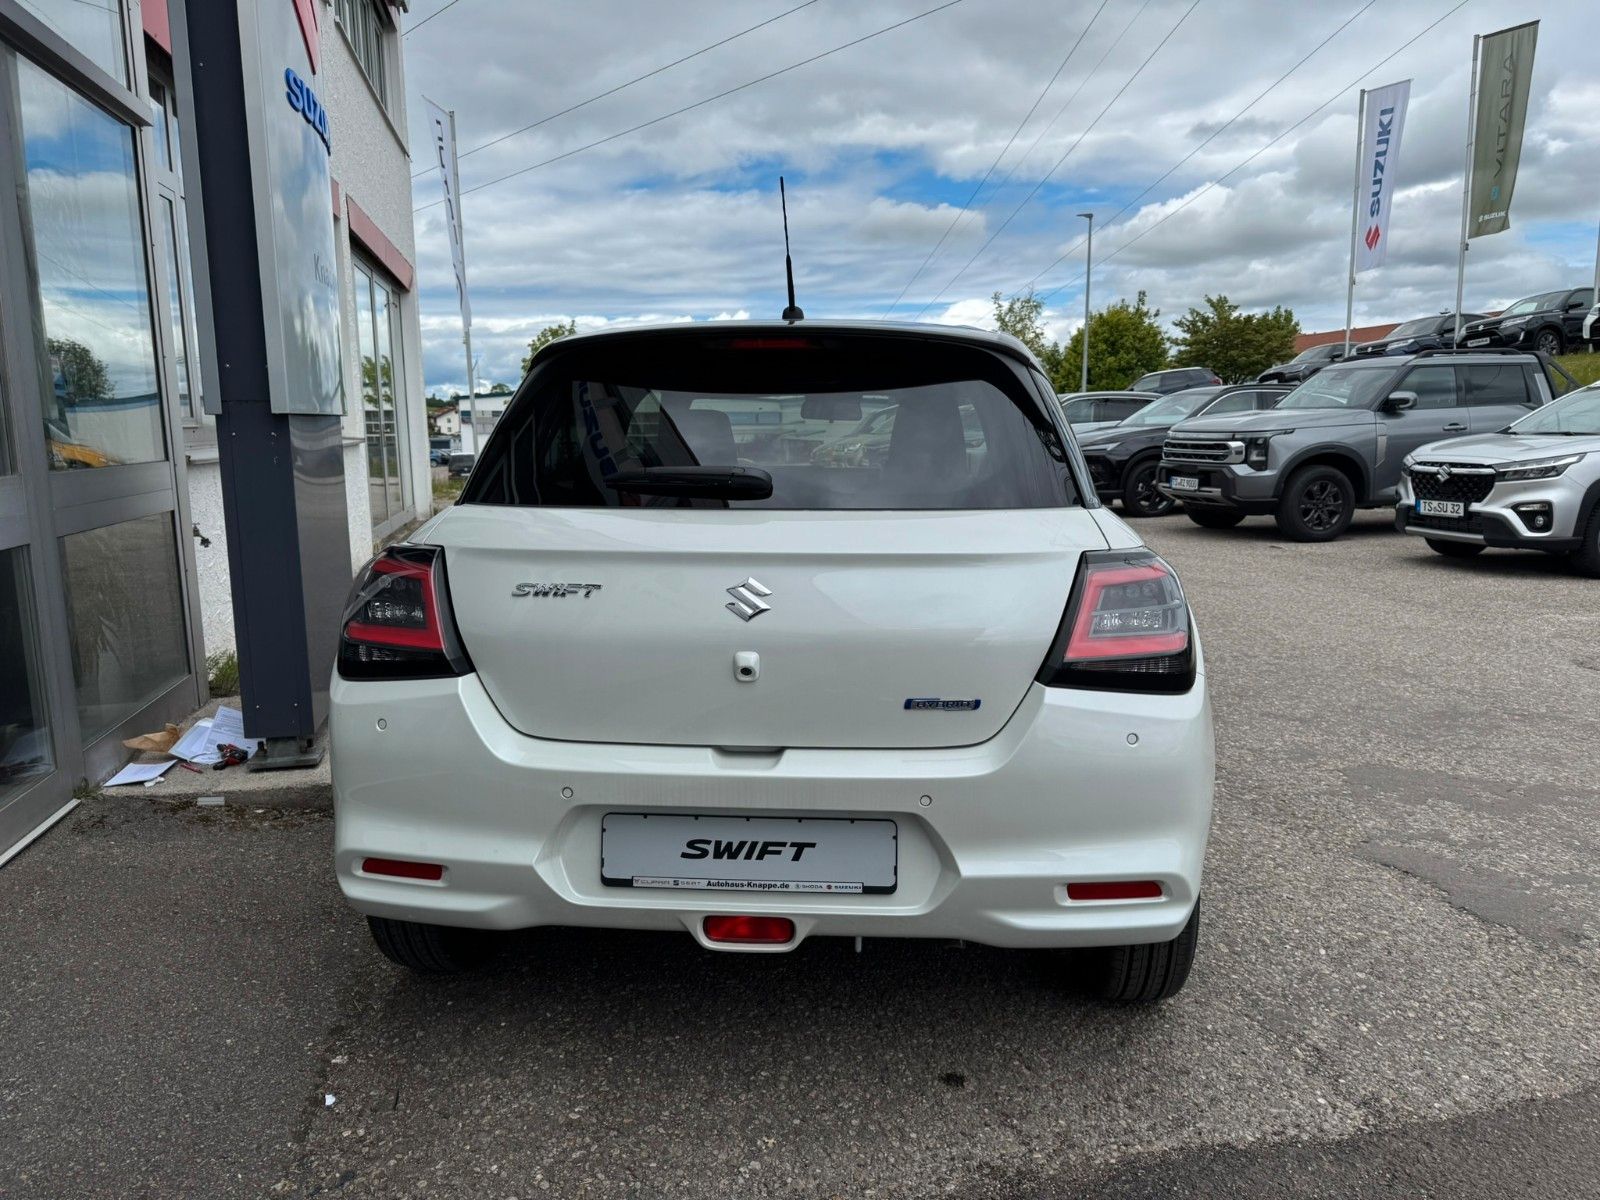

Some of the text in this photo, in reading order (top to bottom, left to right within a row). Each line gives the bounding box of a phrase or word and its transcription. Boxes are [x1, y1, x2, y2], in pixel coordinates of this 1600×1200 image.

[1494, 52, 1515, 178] VITARA
[1370, 107, 1394, 218] SUZUKI
[1423, 501, 1461, 514] TS SU 32
[511, 582, 602, 598] SWIFT
[680, 838, 817, 862] SWIFT
[706, 879, 790, 890] Autohaus-Knappe.de
